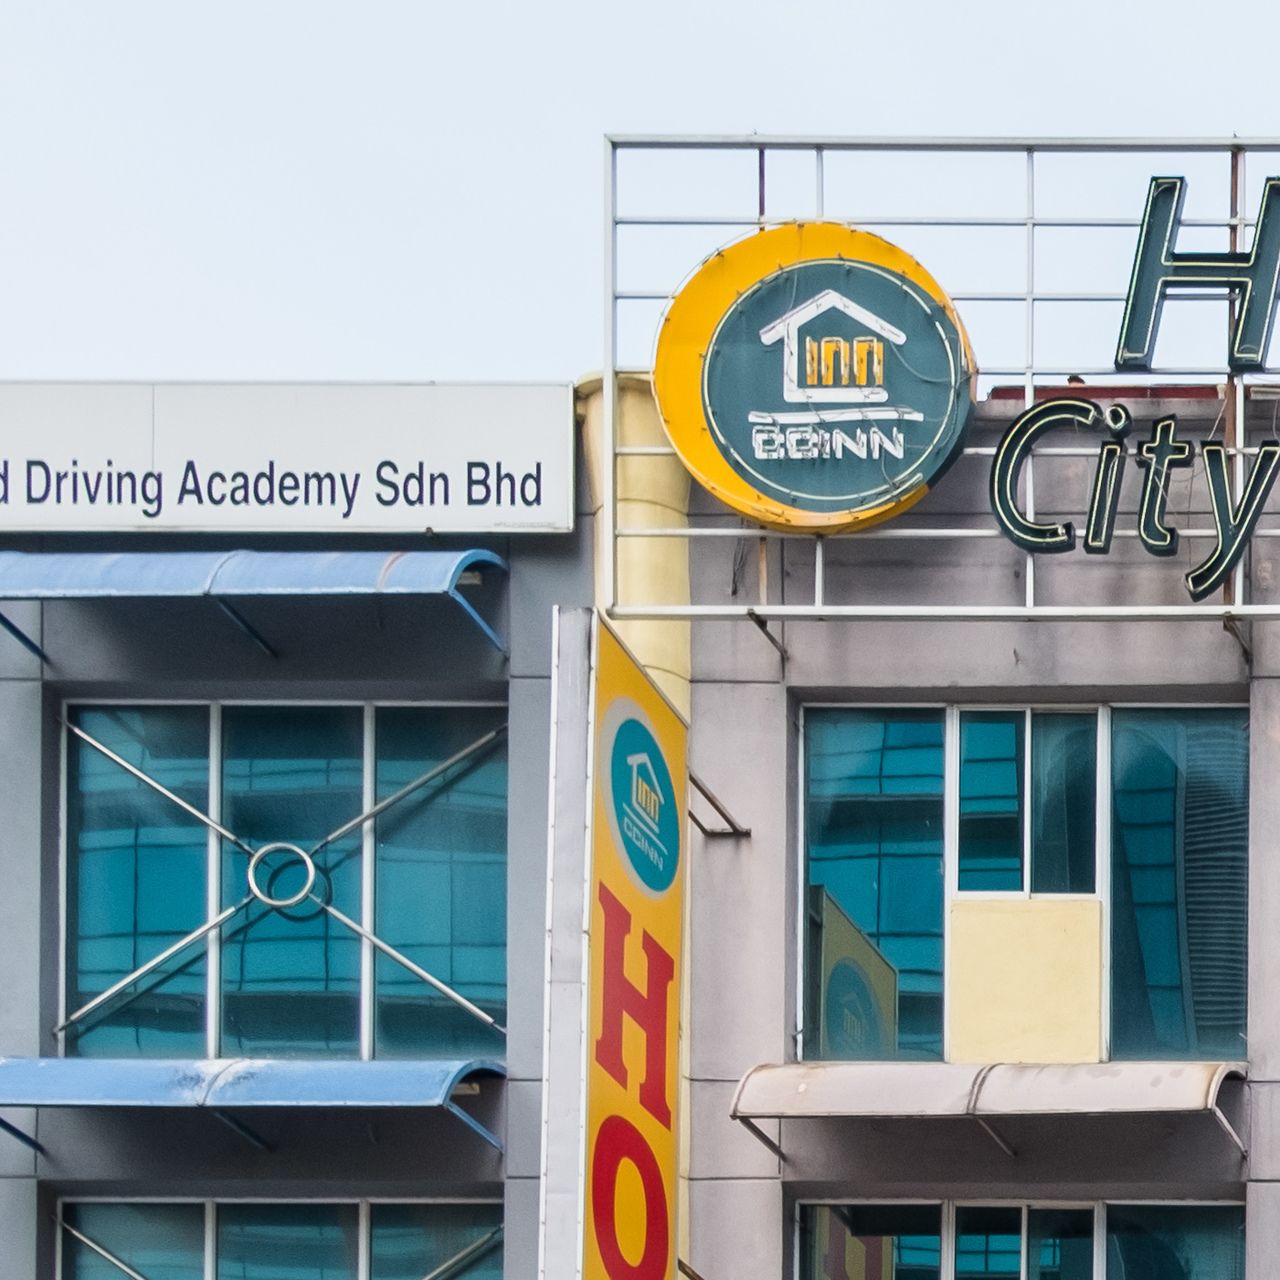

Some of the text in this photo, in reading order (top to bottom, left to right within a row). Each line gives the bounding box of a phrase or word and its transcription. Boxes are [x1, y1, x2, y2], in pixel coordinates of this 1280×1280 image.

[26, 459, 163, 518] Driving
[178, 460, 360, 518] Academy
[375, 461, 451, 506] Sdn
[466, 461, 542, 506] Bhd
[623, 816, 664, 872] CCINN
